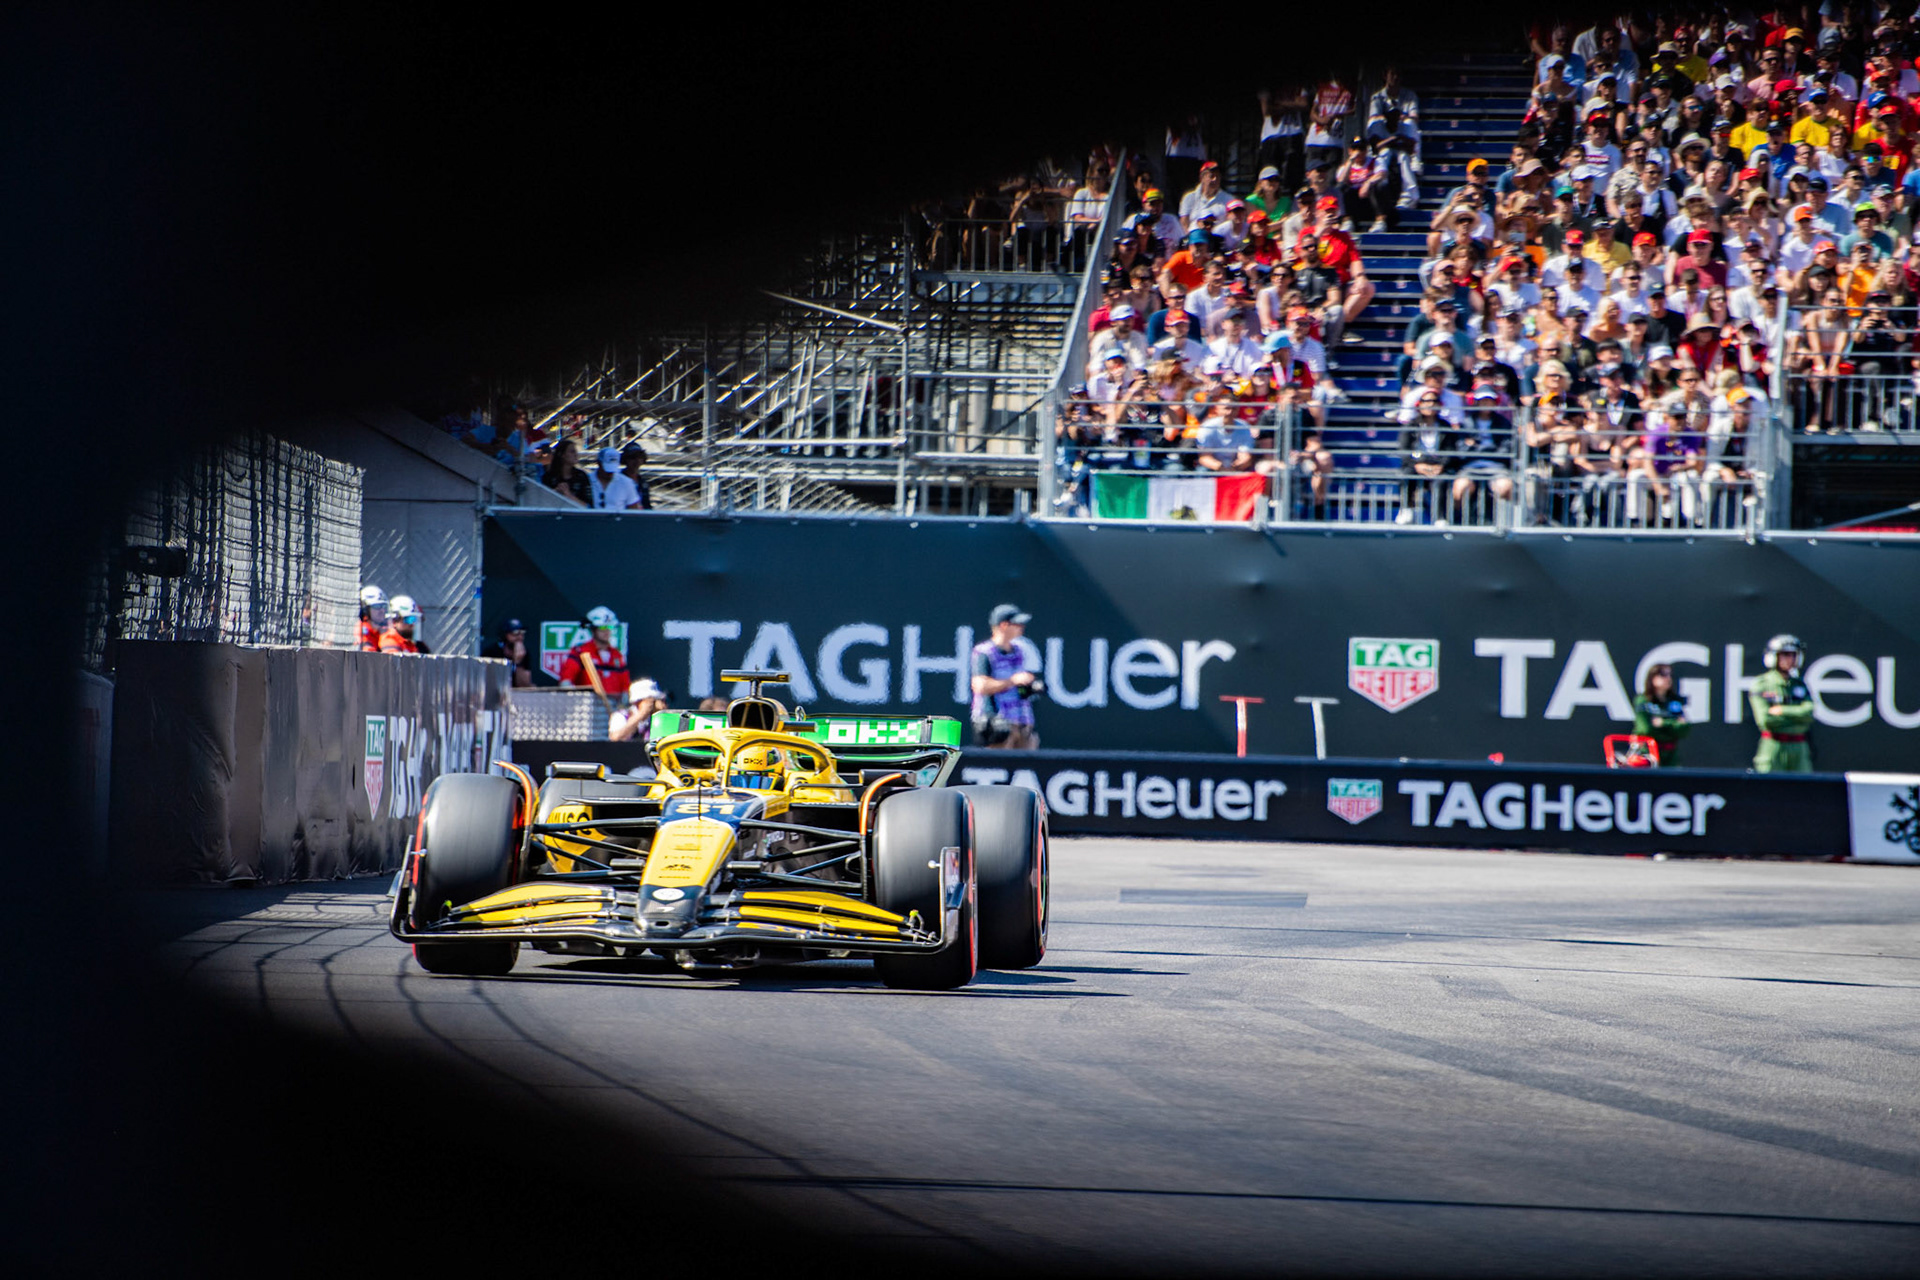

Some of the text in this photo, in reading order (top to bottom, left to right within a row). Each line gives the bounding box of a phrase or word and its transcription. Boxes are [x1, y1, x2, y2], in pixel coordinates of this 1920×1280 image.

[662, 620, 1236, 710] TAGHuer
[1356, 642, 1431, 667] TAG
[1354, 671, 1434, 707] HEUER
[368, 723, 385, 755] TAG
[828, 719, 919, 745] OKX
[743, 757, 763, 766] OKX
[675, 803, 736, 815] 81
[1398, 779, 1726, 836] TAGHeuer
